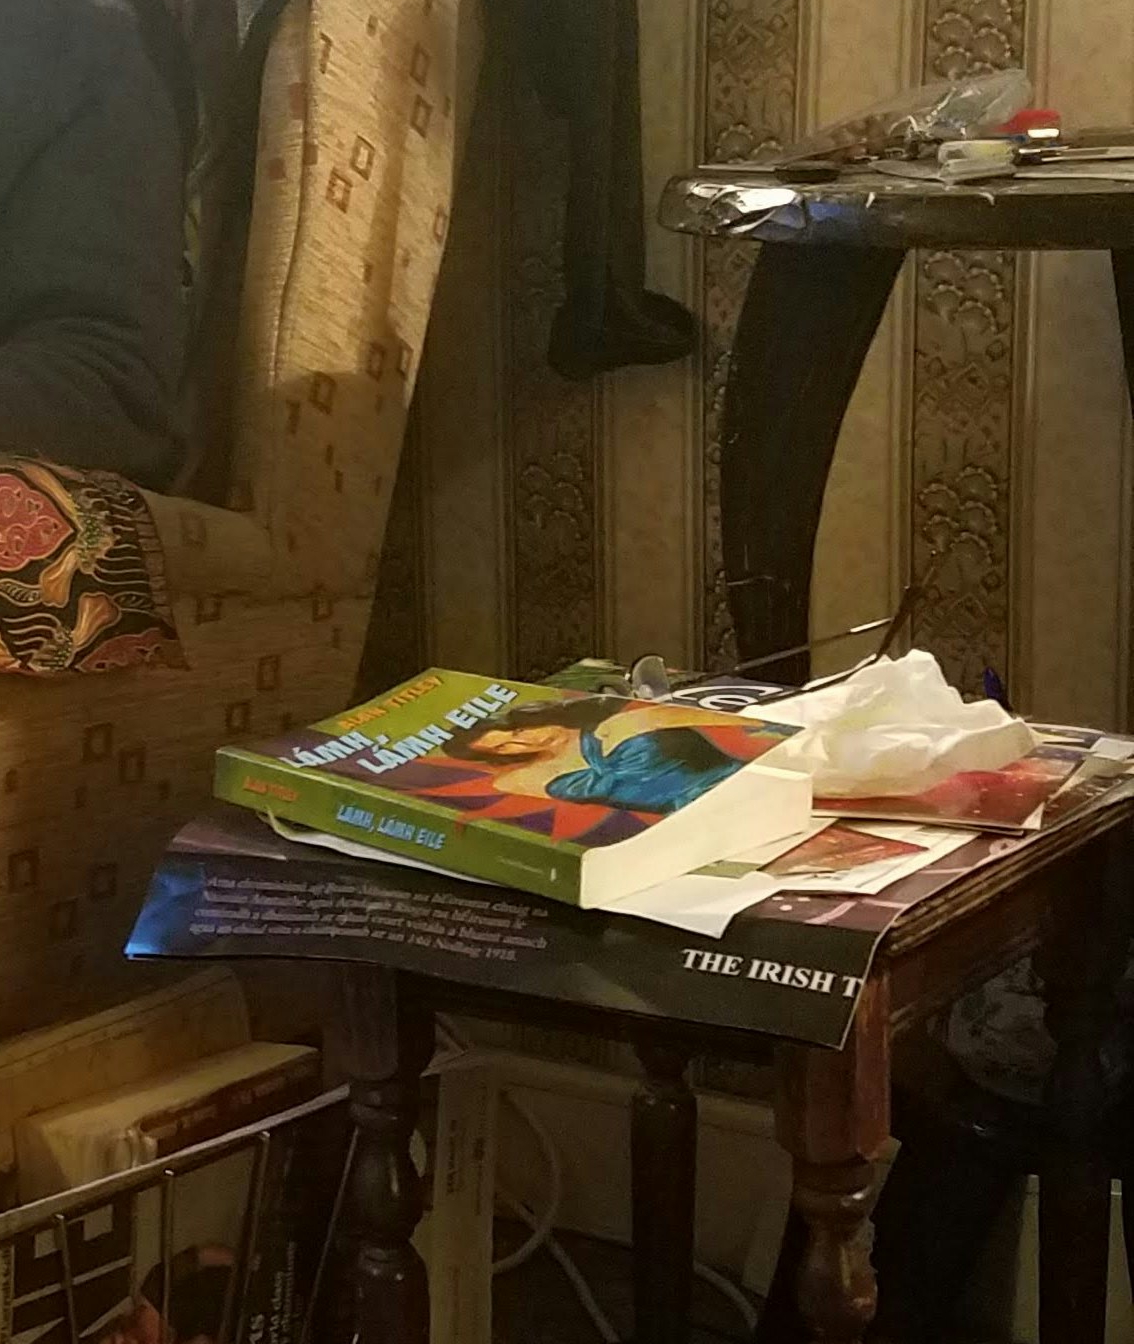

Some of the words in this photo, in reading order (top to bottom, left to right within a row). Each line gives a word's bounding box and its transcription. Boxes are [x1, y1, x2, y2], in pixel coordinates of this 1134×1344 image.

[385, 675, 444, 708] TITLEY
[356, 723, 455, 774] LÁMH
[445, 683, 518, 730] EILE
[416, 828, 446, 850] EILE
[681, 947, 744, 976] THE
[746, 958, 837, 994] IRISH
